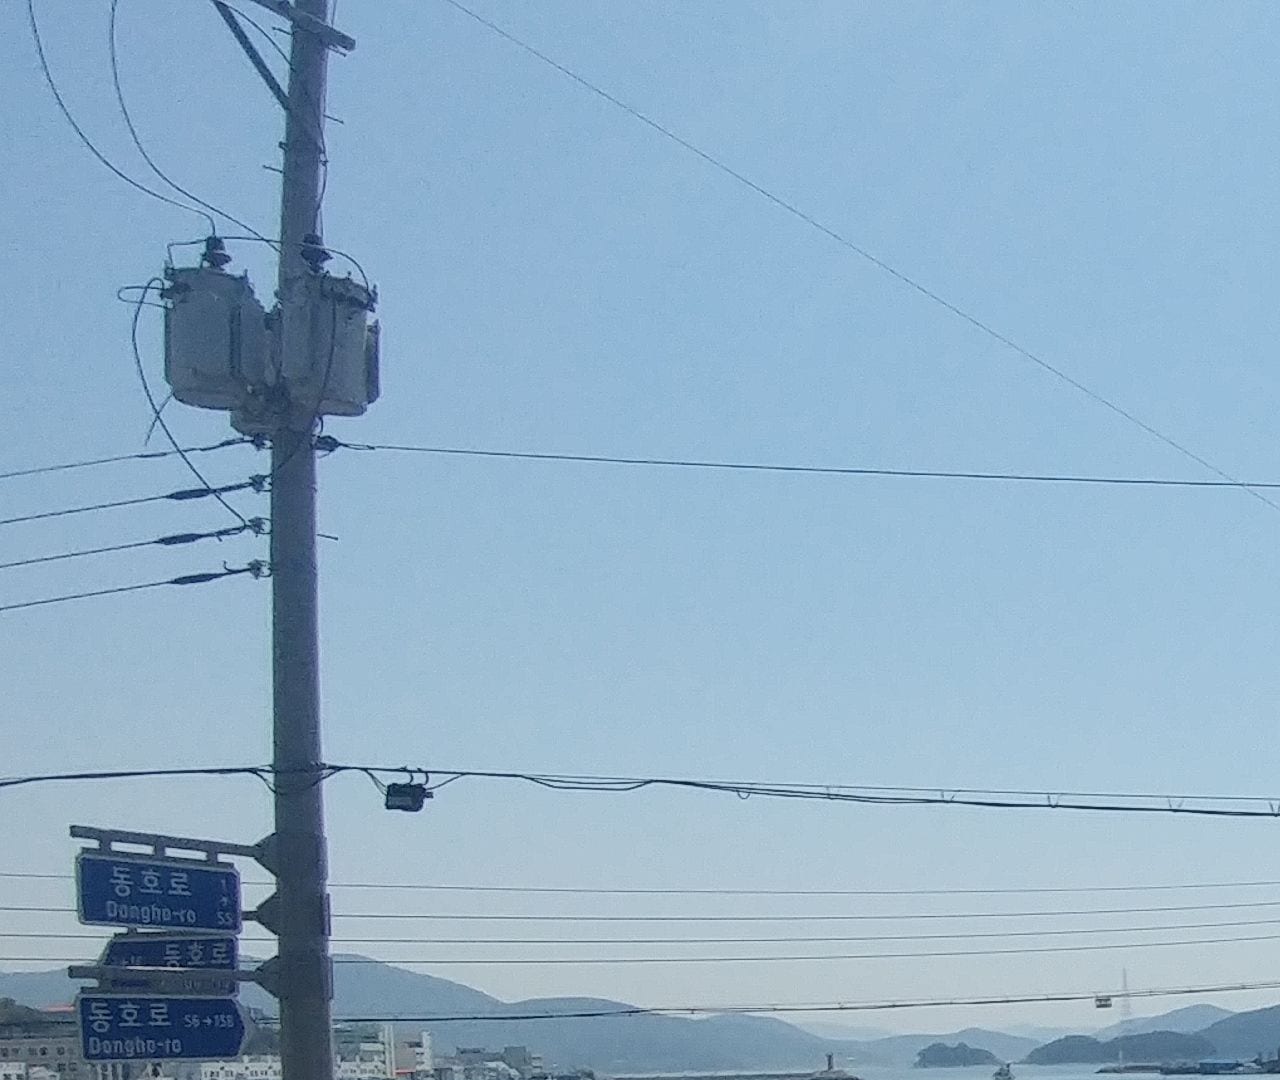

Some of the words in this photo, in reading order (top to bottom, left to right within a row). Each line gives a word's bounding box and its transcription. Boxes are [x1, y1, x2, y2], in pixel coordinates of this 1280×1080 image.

[109, 866, 193, 898] 동호로
[105, 900, 197, 925] Dongho-ro
[88, 1000, 172, 1034] 동호로
[88, 1036, 182, 1057] Dongho-ro
